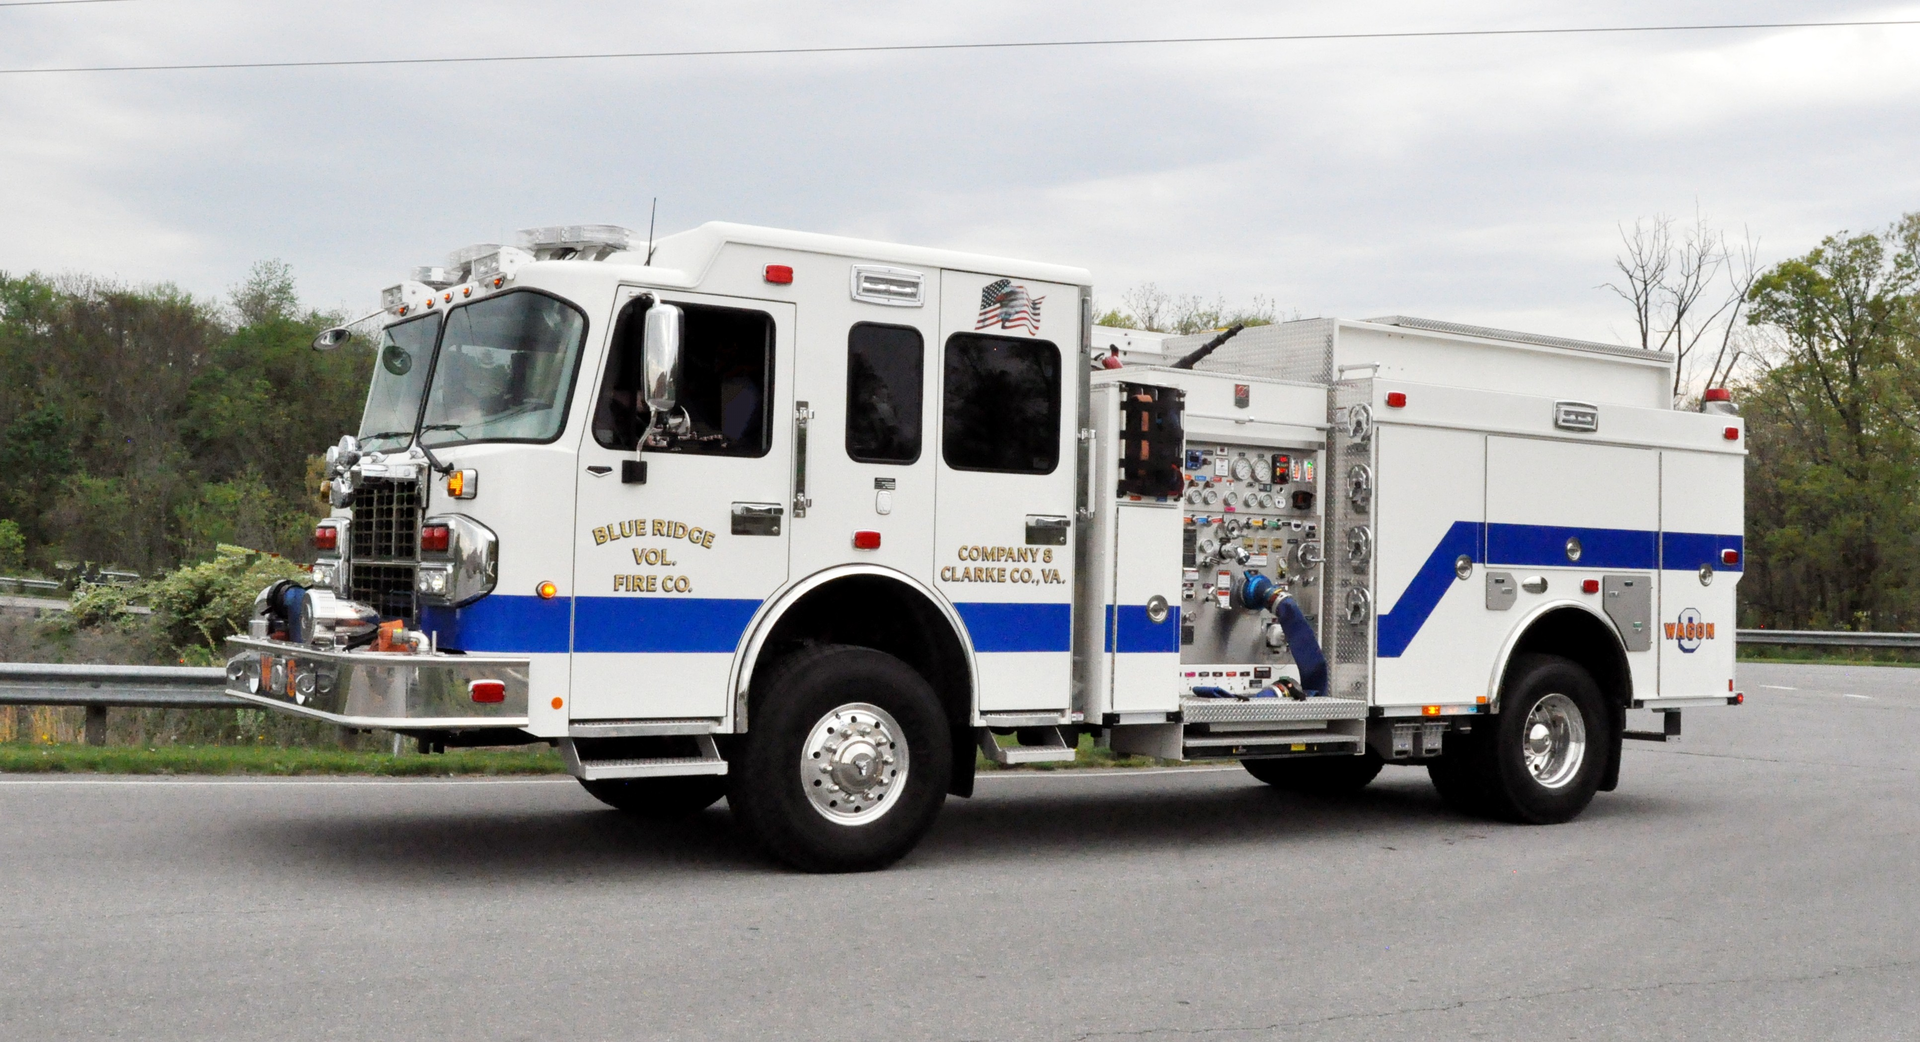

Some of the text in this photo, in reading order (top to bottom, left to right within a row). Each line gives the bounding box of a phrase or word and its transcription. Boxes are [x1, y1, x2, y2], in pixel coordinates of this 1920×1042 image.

[592, 519, 716, 549] BLUE RIDGE
[632, 547, 678, 567] VOL.
[958, 545, 1053, 564] COMPANY 8
[613, 574, 693, 593] FIRE CO.
[940, 565, 1067, 586] CLARKE CO., VA.
[1664, 622, 1715, 640] WAGON
